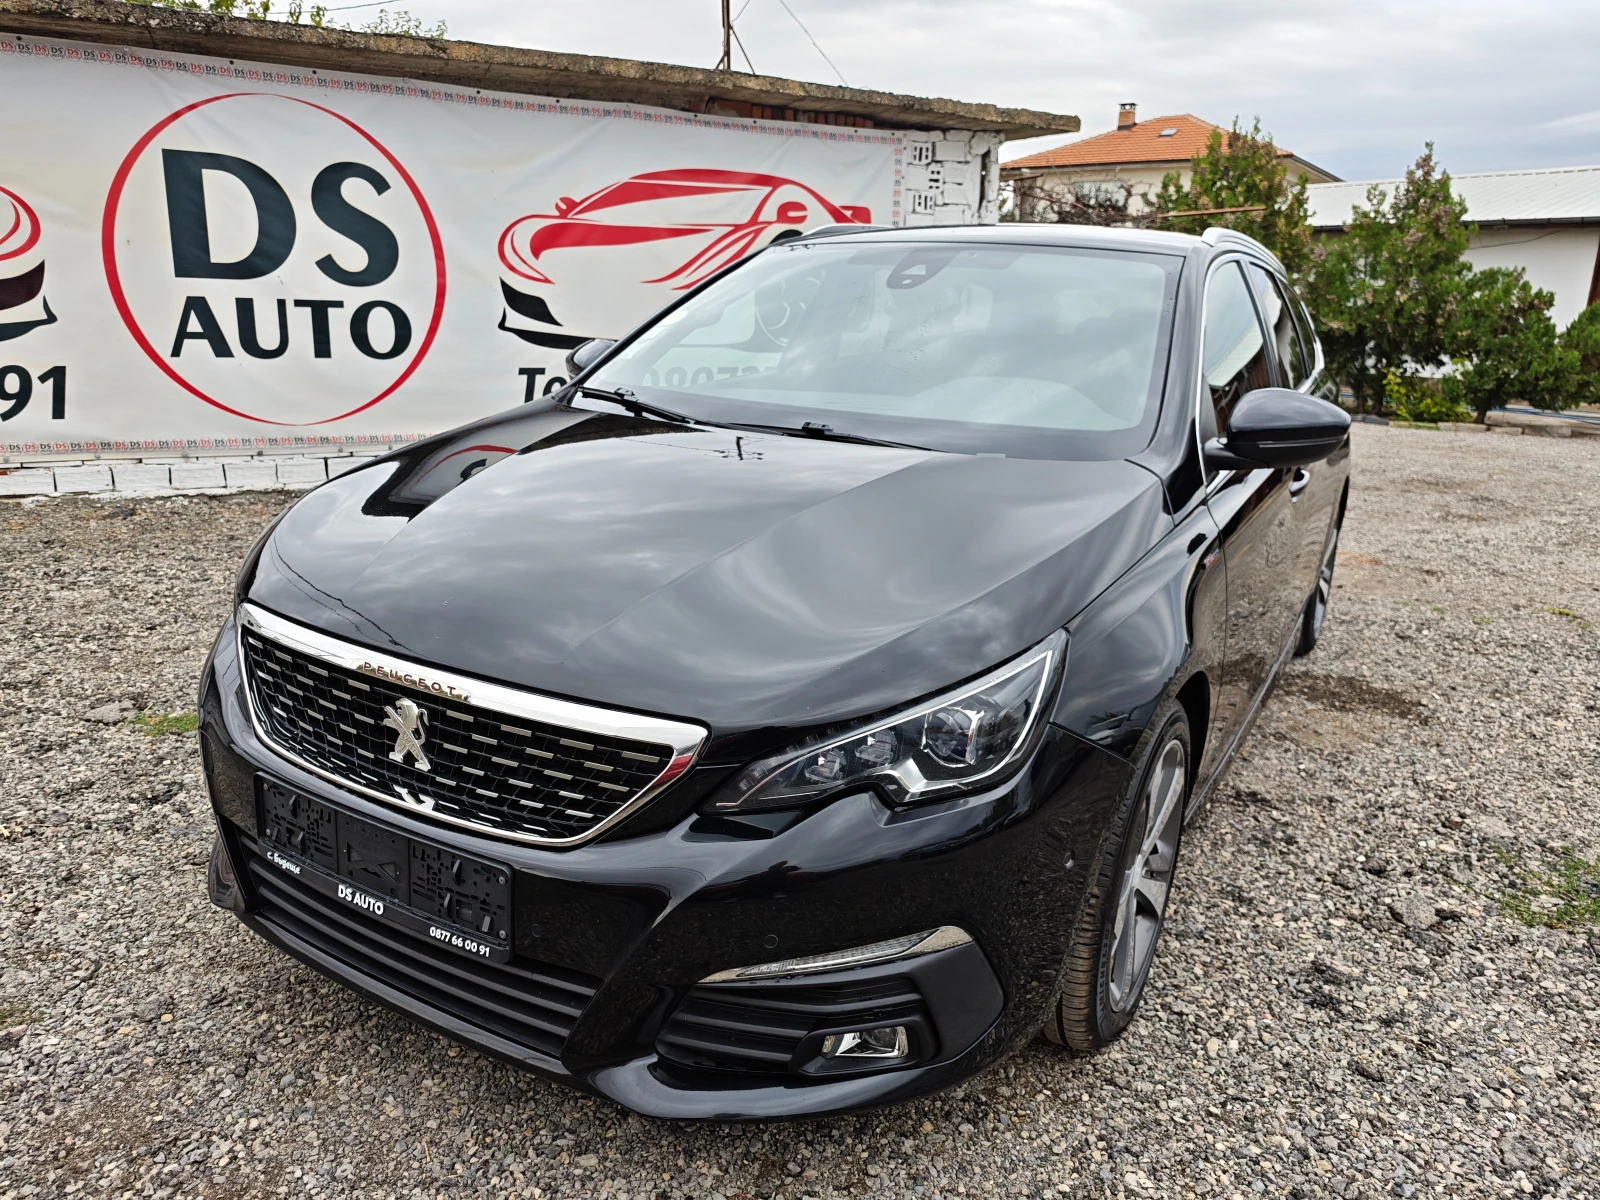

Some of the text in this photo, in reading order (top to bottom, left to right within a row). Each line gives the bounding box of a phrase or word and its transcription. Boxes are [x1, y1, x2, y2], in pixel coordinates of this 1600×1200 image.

[18, 43, 30, 51] DS
[161, 148, 399, 287] DS
[170, 295, 412, 360] AUTO
[0, 364, 67, 422] 91
[363, 661, 456, 696] PEUGEOT
[338, 884, 384, 915] DS AUTO
[429, 926, 490, 957] 0877 66 00 91
